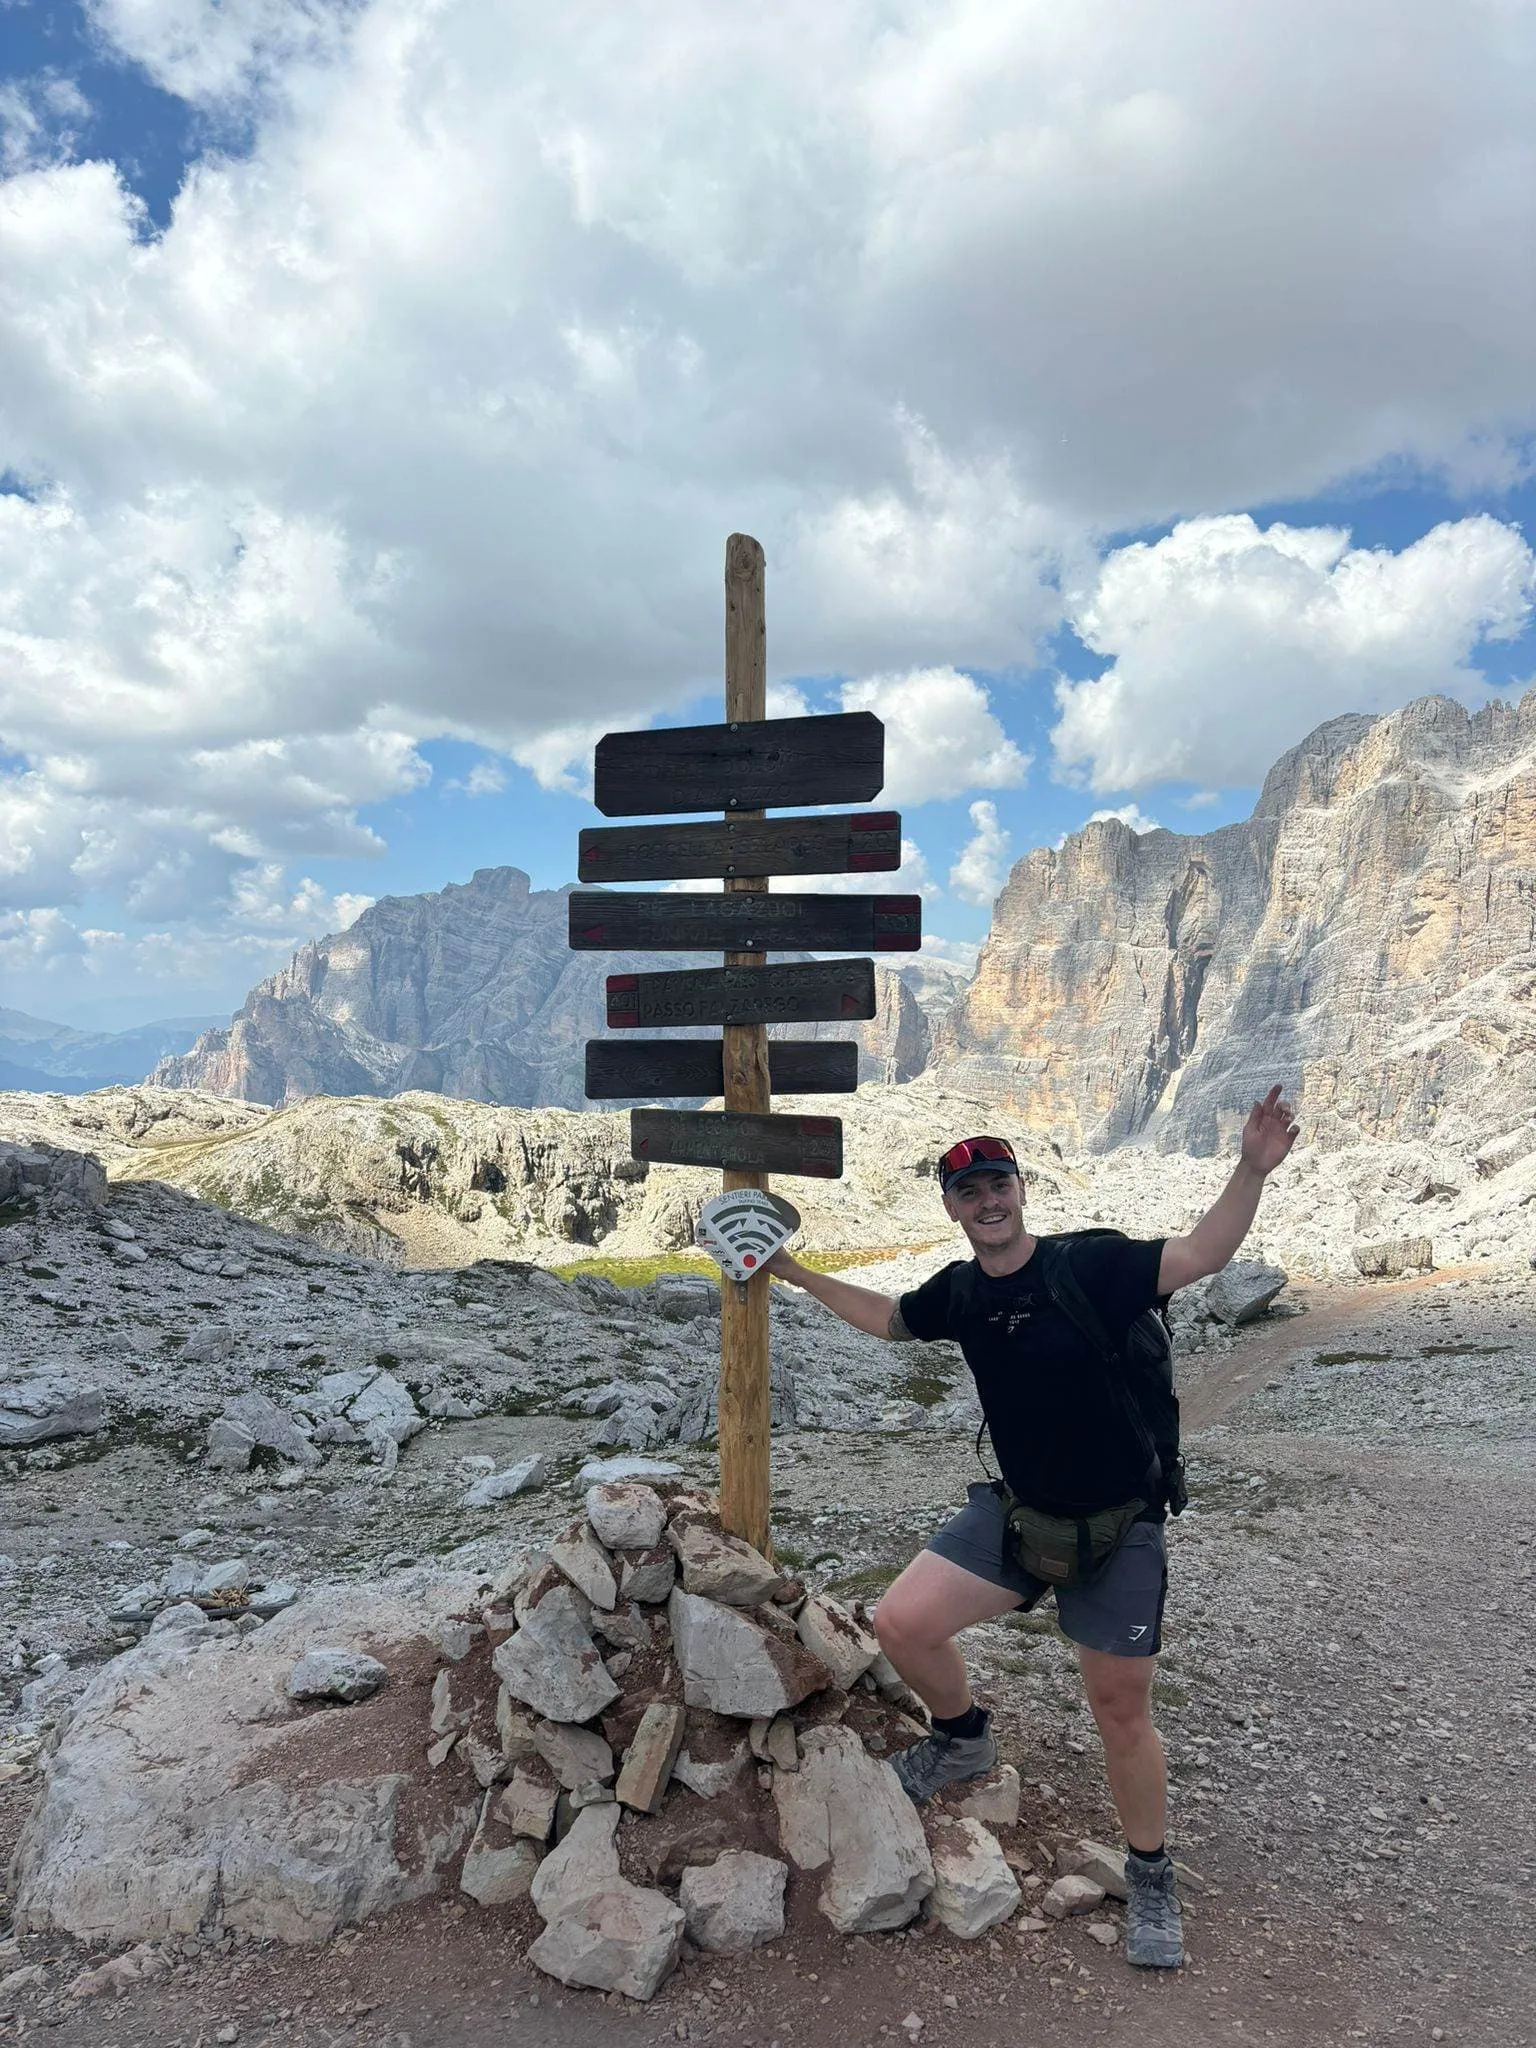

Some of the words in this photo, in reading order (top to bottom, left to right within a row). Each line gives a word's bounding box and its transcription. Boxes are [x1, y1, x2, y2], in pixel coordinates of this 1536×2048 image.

[690, 901, 803, 918] LAGAZUOI
[643, 1000, 695, 1020] PASSO
[718, 1190, 751, 1206] SENTIERI
